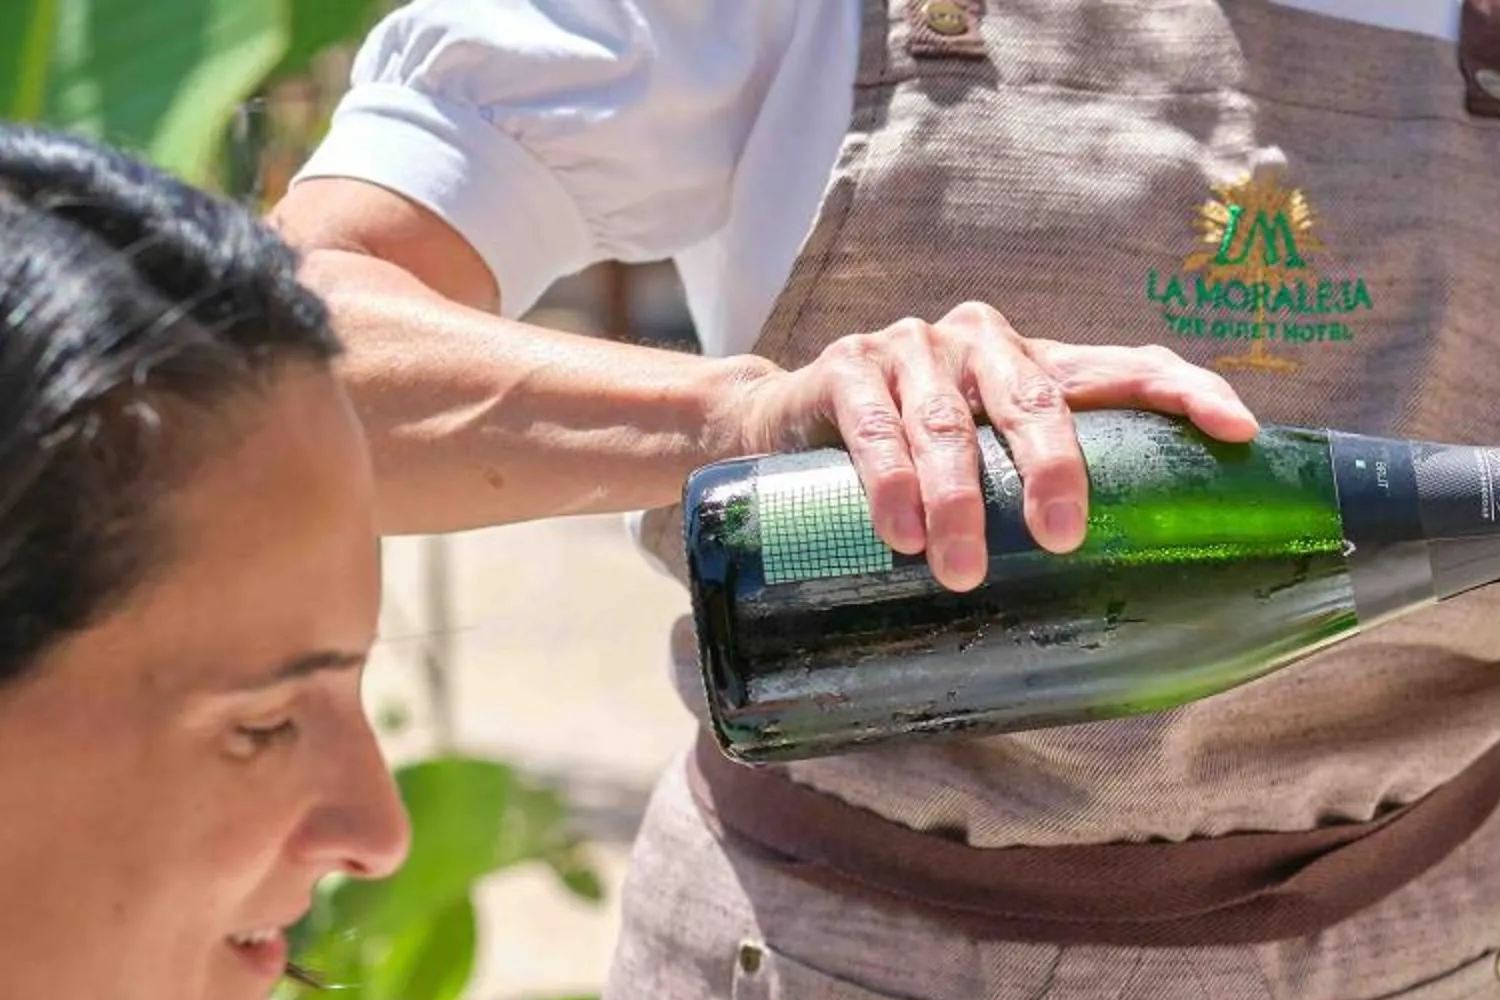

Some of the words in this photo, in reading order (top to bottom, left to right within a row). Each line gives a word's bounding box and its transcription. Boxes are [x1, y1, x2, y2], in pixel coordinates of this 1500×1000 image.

[1147, 267, 1186, 307] LA
[1195, 275, 1373, 315] MORALEJA
[1164, 313, 1205, 337] THE
[1211, 321, 1277, 341] QUIET
[1284, 323, 1354, 343] HOTEL
[1375, 461, 1389, 489] BRUT
